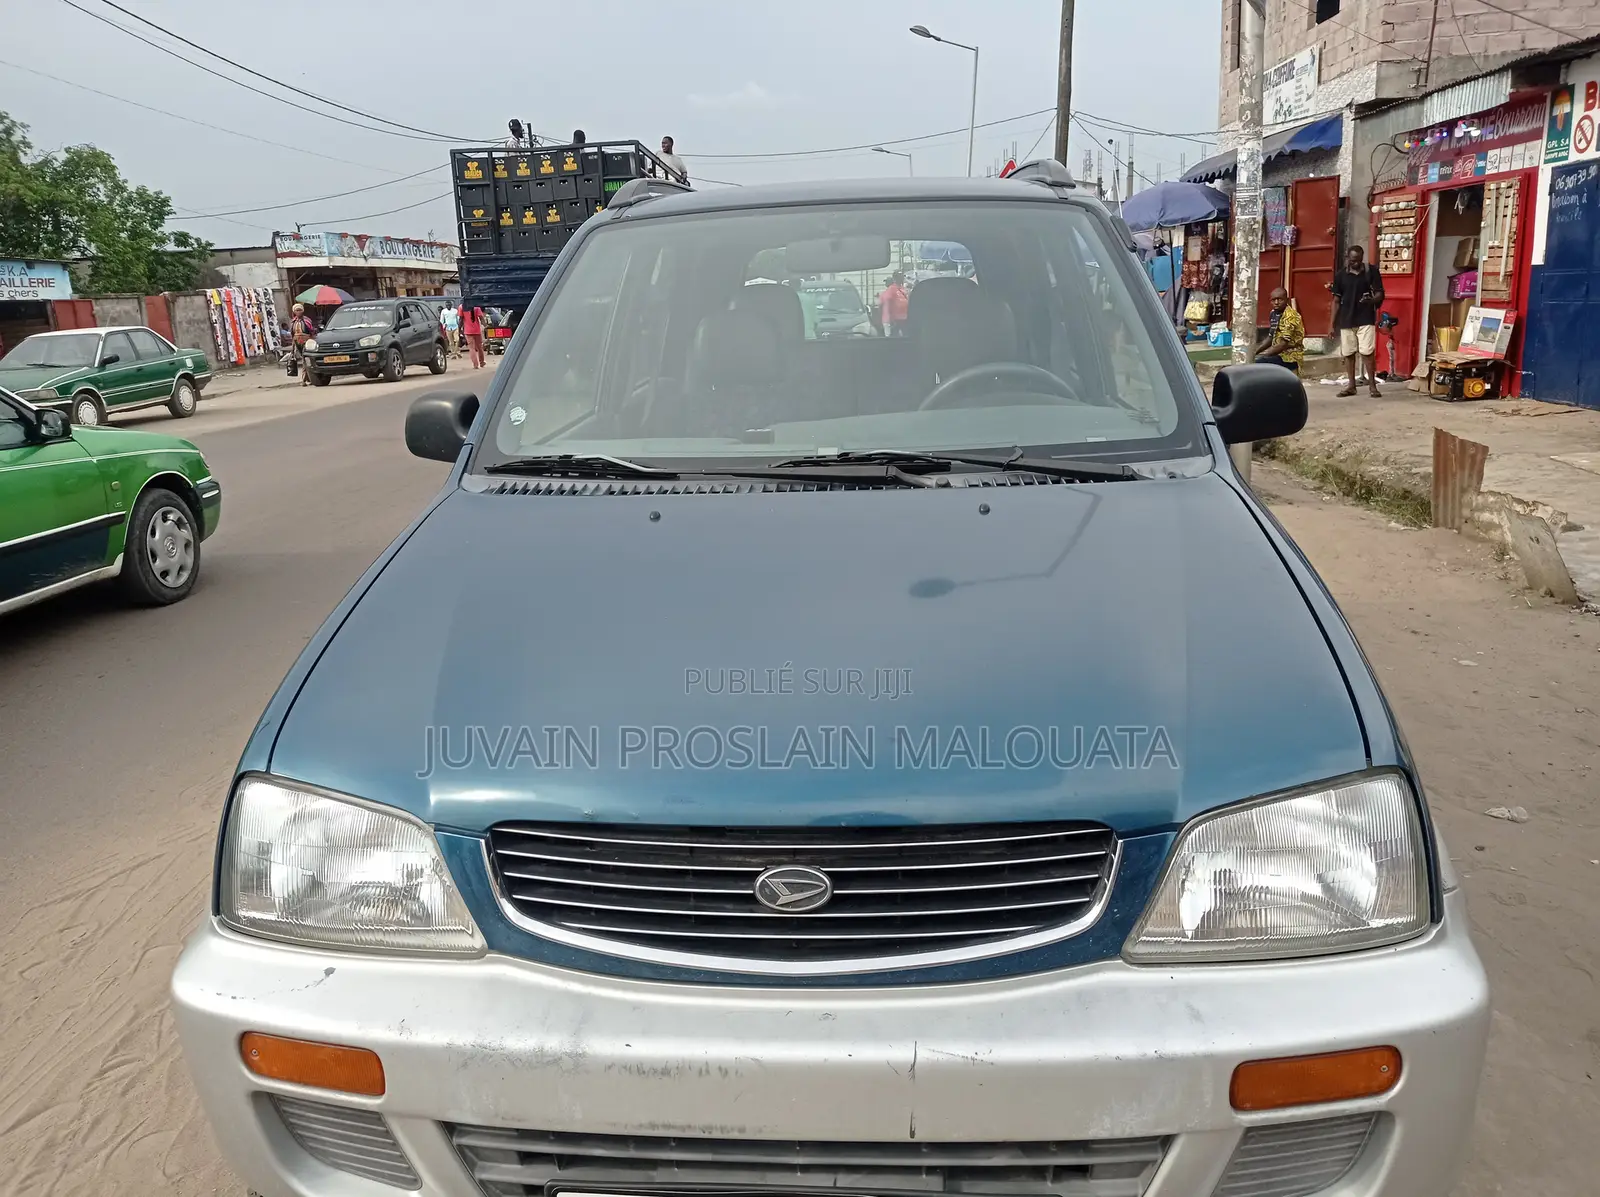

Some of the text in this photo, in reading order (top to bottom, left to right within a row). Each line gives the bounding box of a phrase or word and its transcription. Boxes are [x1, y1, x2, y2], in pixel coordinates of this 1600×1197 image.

[1547, 140, 1558, 149] GPL
[379, 240, 435, 259] BOULANGERIE
[8, 289, 38, 298] chers
